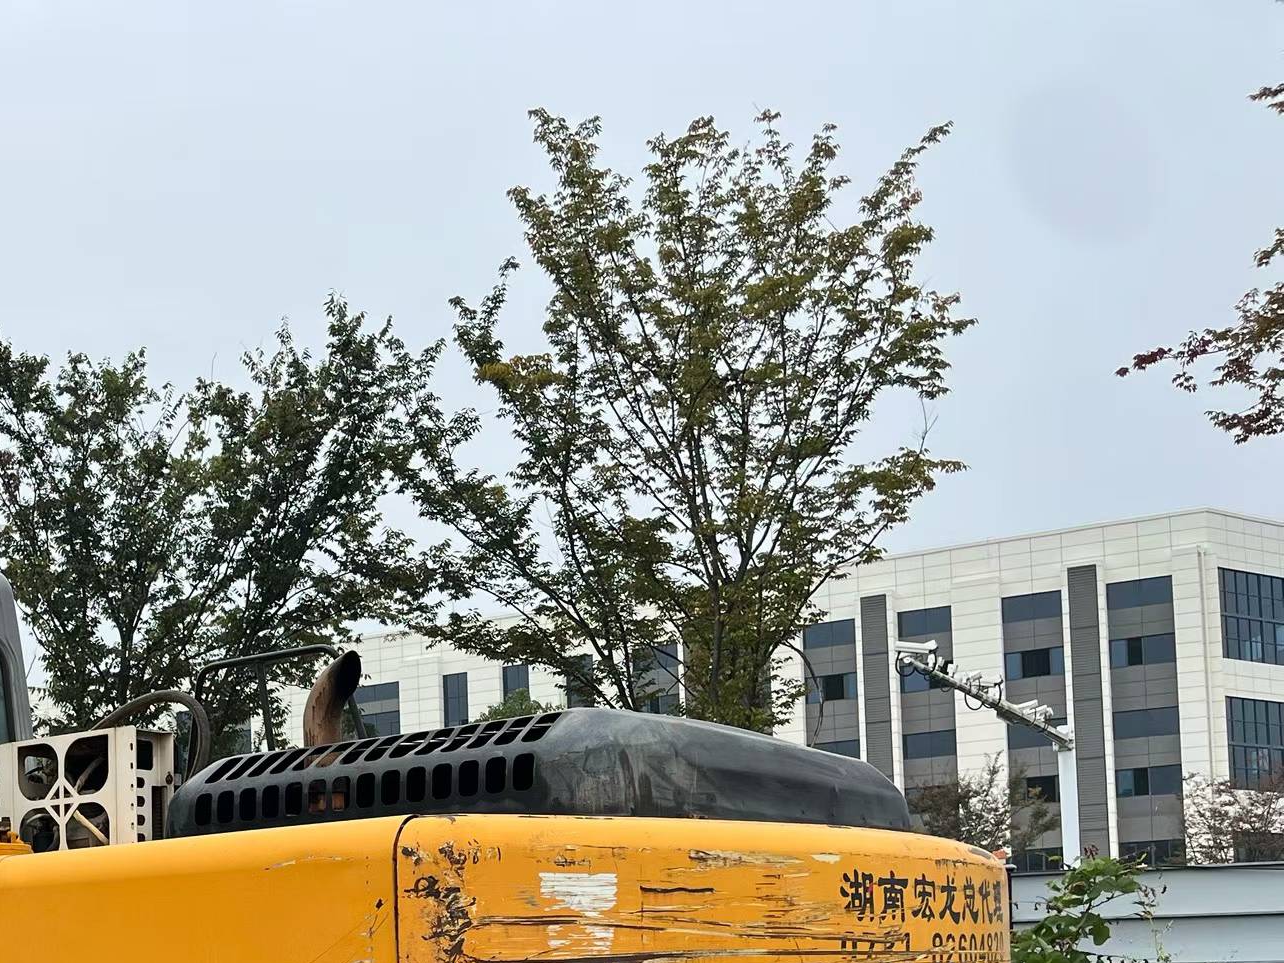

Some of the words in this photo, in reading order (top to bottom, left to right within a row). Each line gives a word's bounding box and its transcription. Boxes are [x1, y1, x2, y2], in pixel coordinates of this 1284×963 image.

[840, 869, 1004, 924] 湖南宏龙总代理
